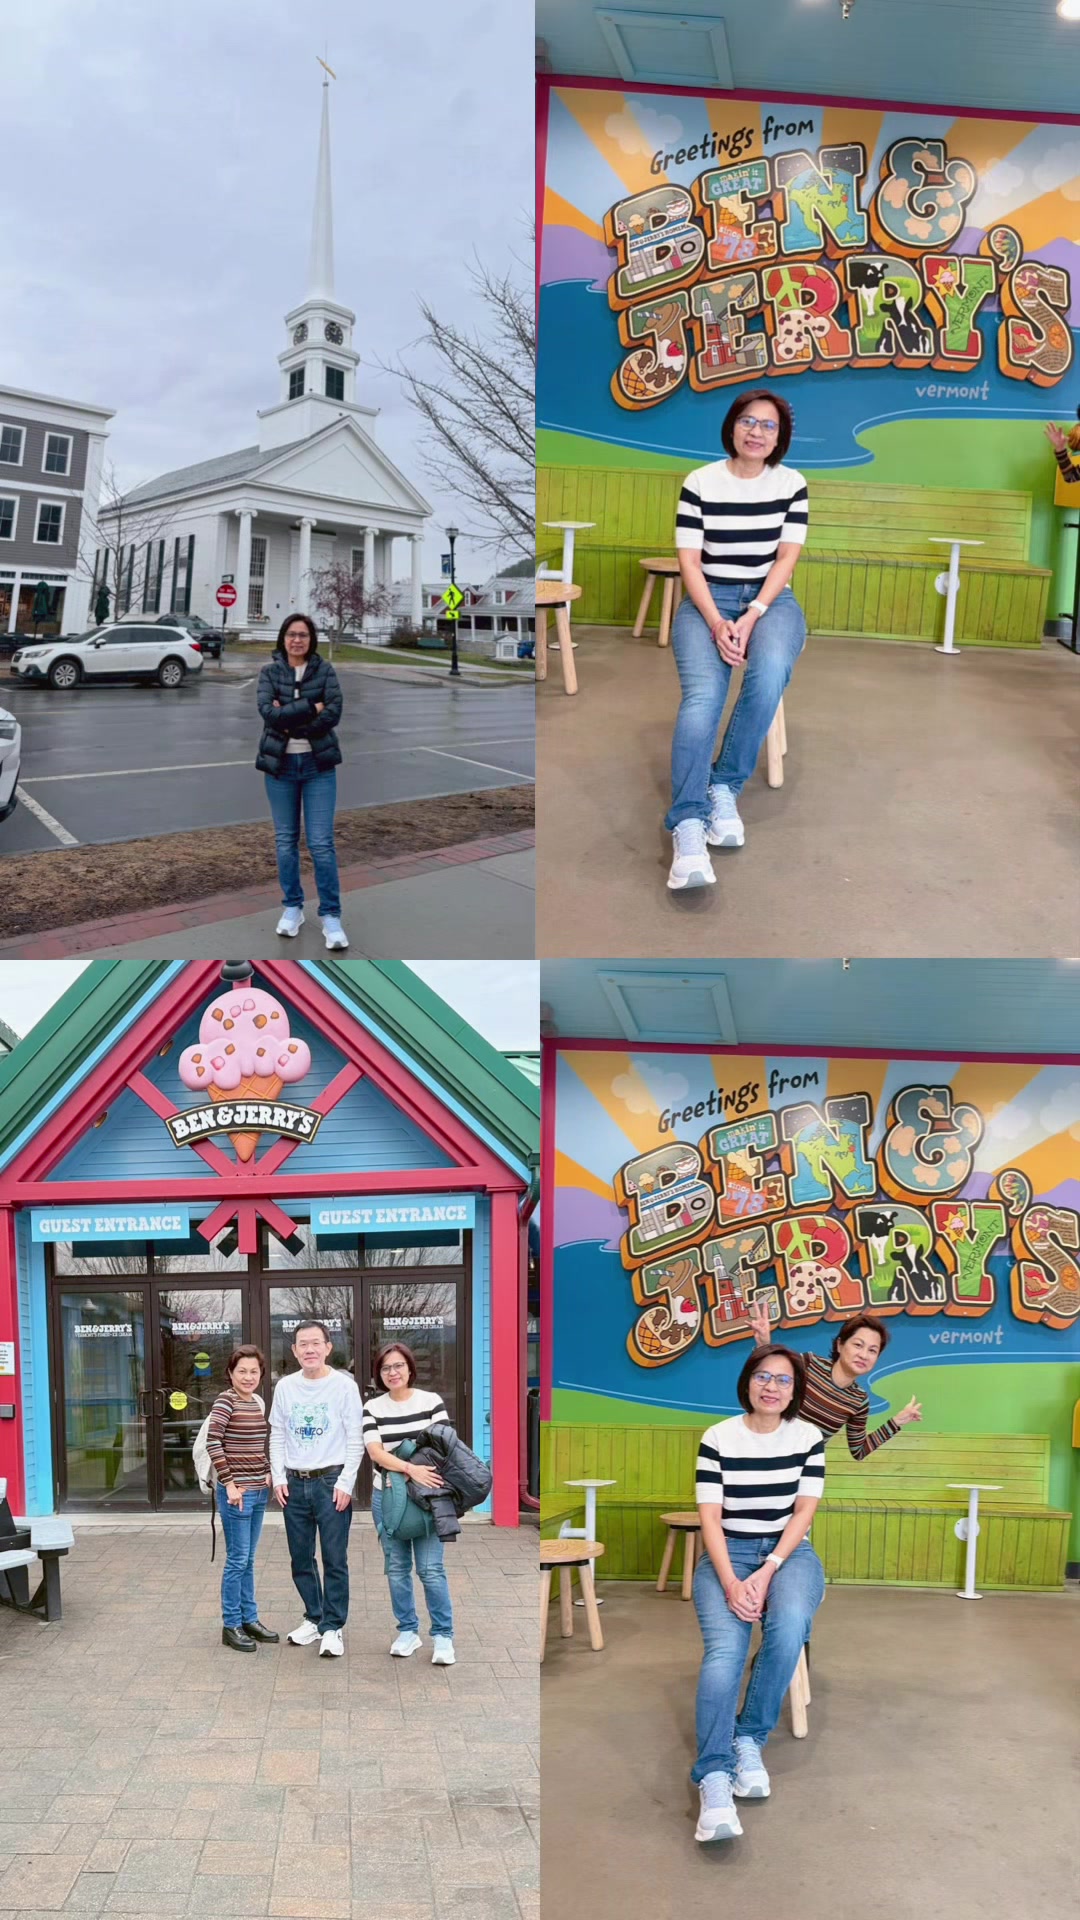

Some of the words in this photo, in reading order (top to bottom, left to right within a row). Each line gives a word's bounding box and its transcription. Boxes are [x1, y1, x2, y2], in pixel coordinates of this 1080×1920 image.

[650, 126, 754, 175] Greetings
[763, 116, 814, 144] from
[711, 176, 763, 196] GREAT
[606, 143, 870, 308] BEN
[870, 137, 978, 254] &
[950, 274, 988, 335] VERMONT
[610, 225, 1076, 410] JERRY'S
[915, 380, 990, 401] vermont
[658, 1081, 760, 1133] Greetings
[768, 1069, 819, 1098] from
[171, 1103, 315, 1140] BEN&JERRY'S
[718, 1132, 769, 1152] GREAT
[614, 1093, 877, 1269] BEN
[877, 1084, 986, 1206] &
[38, 1216, 91, 1233] GUEST
[94, 1214, 181, 1232] ENTRANCE
[318, 1208, 373, 1225] GUEST
[375, 1204, 467, 1223] ENTRANCE
[962, 1219, 1001, 1281] VERMONT
[627, 1168, 1080, 1368] JERRY'S
[74, 1324, 132, 1333] BEN&JERRY'S
[171, 1321, 230, 1331] BEN&JERRY'S
[383, 1316, 444, 1326] BEN&JERRY'S
[929, 1324, 1004, 1345] vermont
[294, 1426, 324, 1436] KENZO
